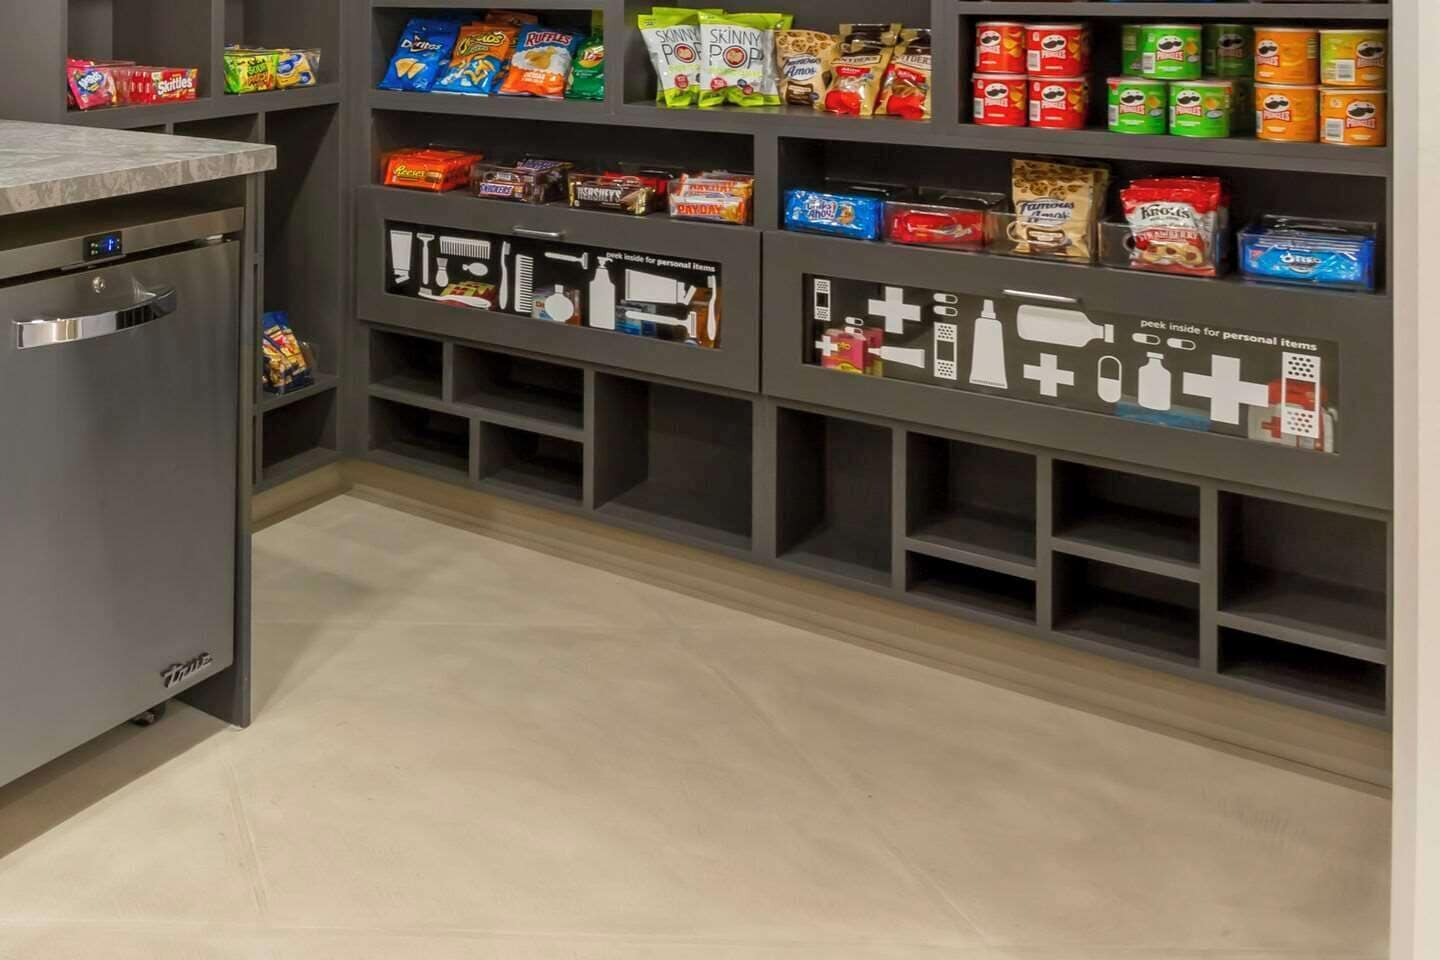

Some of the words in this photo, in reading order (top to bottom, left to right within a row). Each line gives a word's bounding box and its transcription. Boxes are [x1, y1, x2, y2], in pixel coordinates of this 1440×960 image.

[526, 31, 572, 46] RUFFLES
[710, 28, 761, 46] SKINNY
[786, 66, 816, 76] Amos
[157, 76, 192, 96] Skittles
[577, 186, 622, 203] HERSHEY'S
[624, 253, 644, 262] inside
[645, 256, 656, 264] for
[657, 259, 691, 269] personal
[693, 262, 715, 272] items
[1141, 319, 1166, 331] peek
[1170, 322, 1200, 335] inside
[1204, 327, 1220, 337] for
[1223, 331, 1277, 346] personal
[1281, 338, 1317, 351] items
